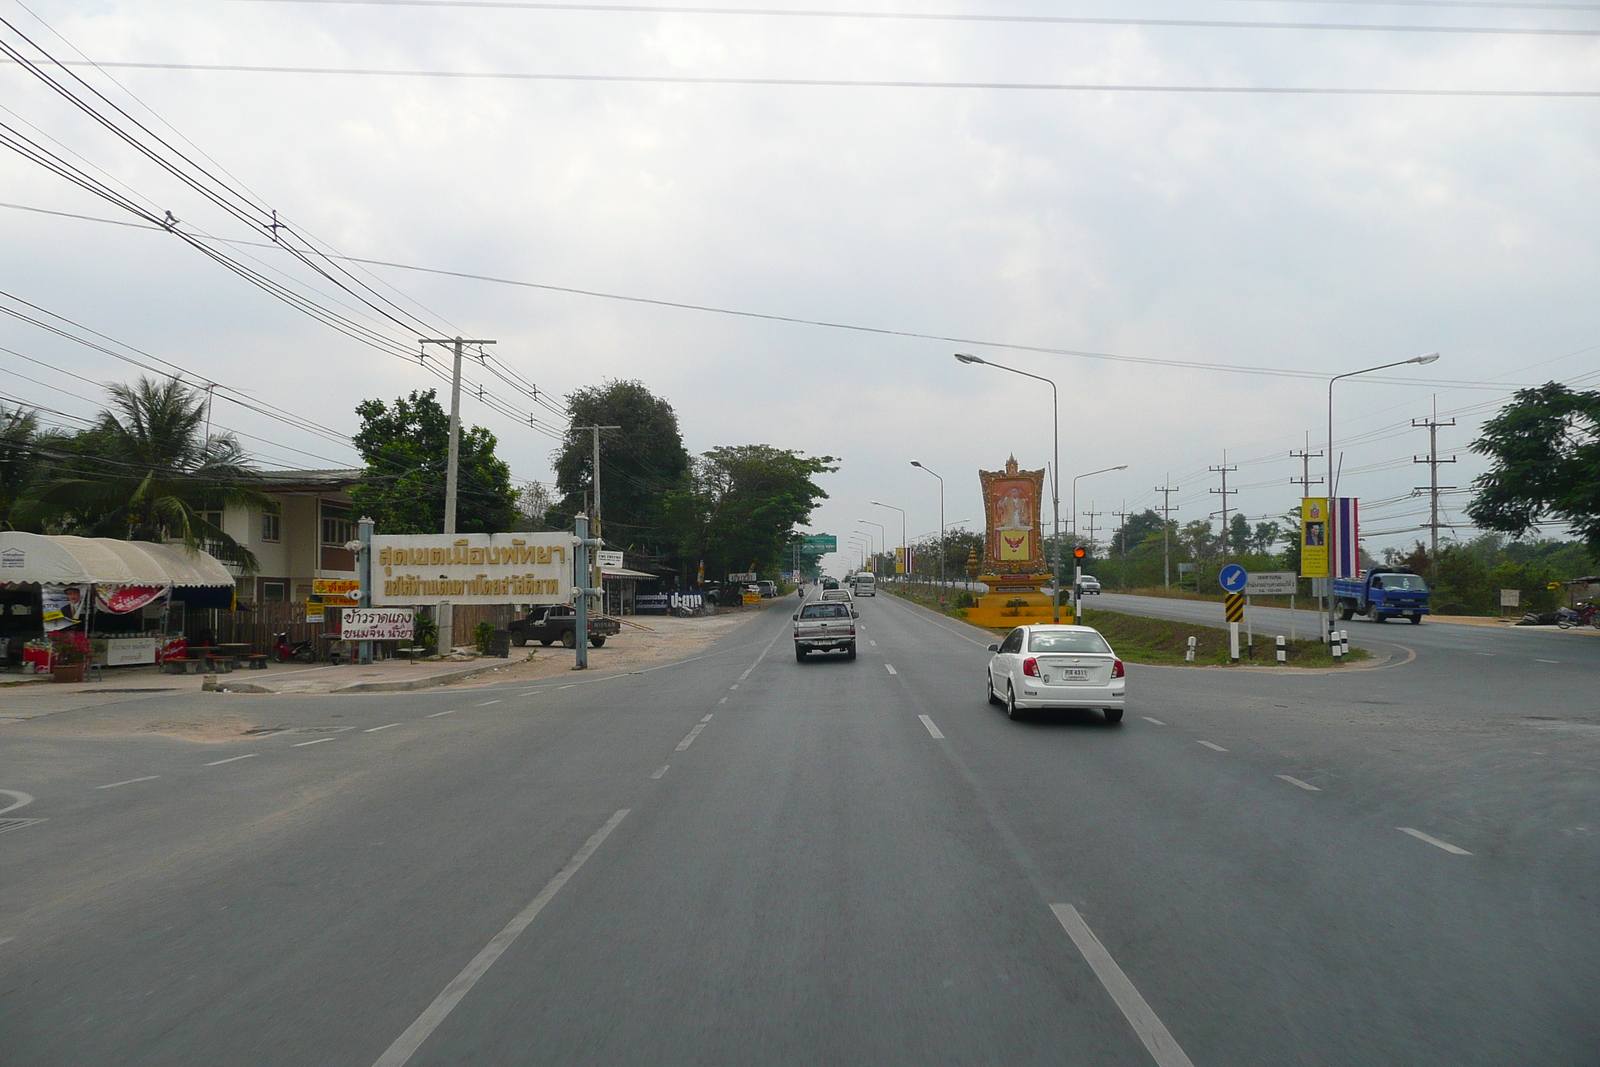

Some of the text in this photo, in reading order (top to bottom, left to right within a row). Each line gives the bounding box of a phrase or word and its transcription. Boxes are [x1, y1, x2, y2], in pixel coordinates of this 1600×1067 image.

[379, 539, 565, 576] สุดเขตเมืองพัทยา
[384, 574, 559, 596] ขอให้ท่านเดินทางโดยสวัสดิภาพ
[343, 608, 412, 624] ข้าวราดแกง
[343, 624, 413, 639] ขนมจีน น้ำยา
